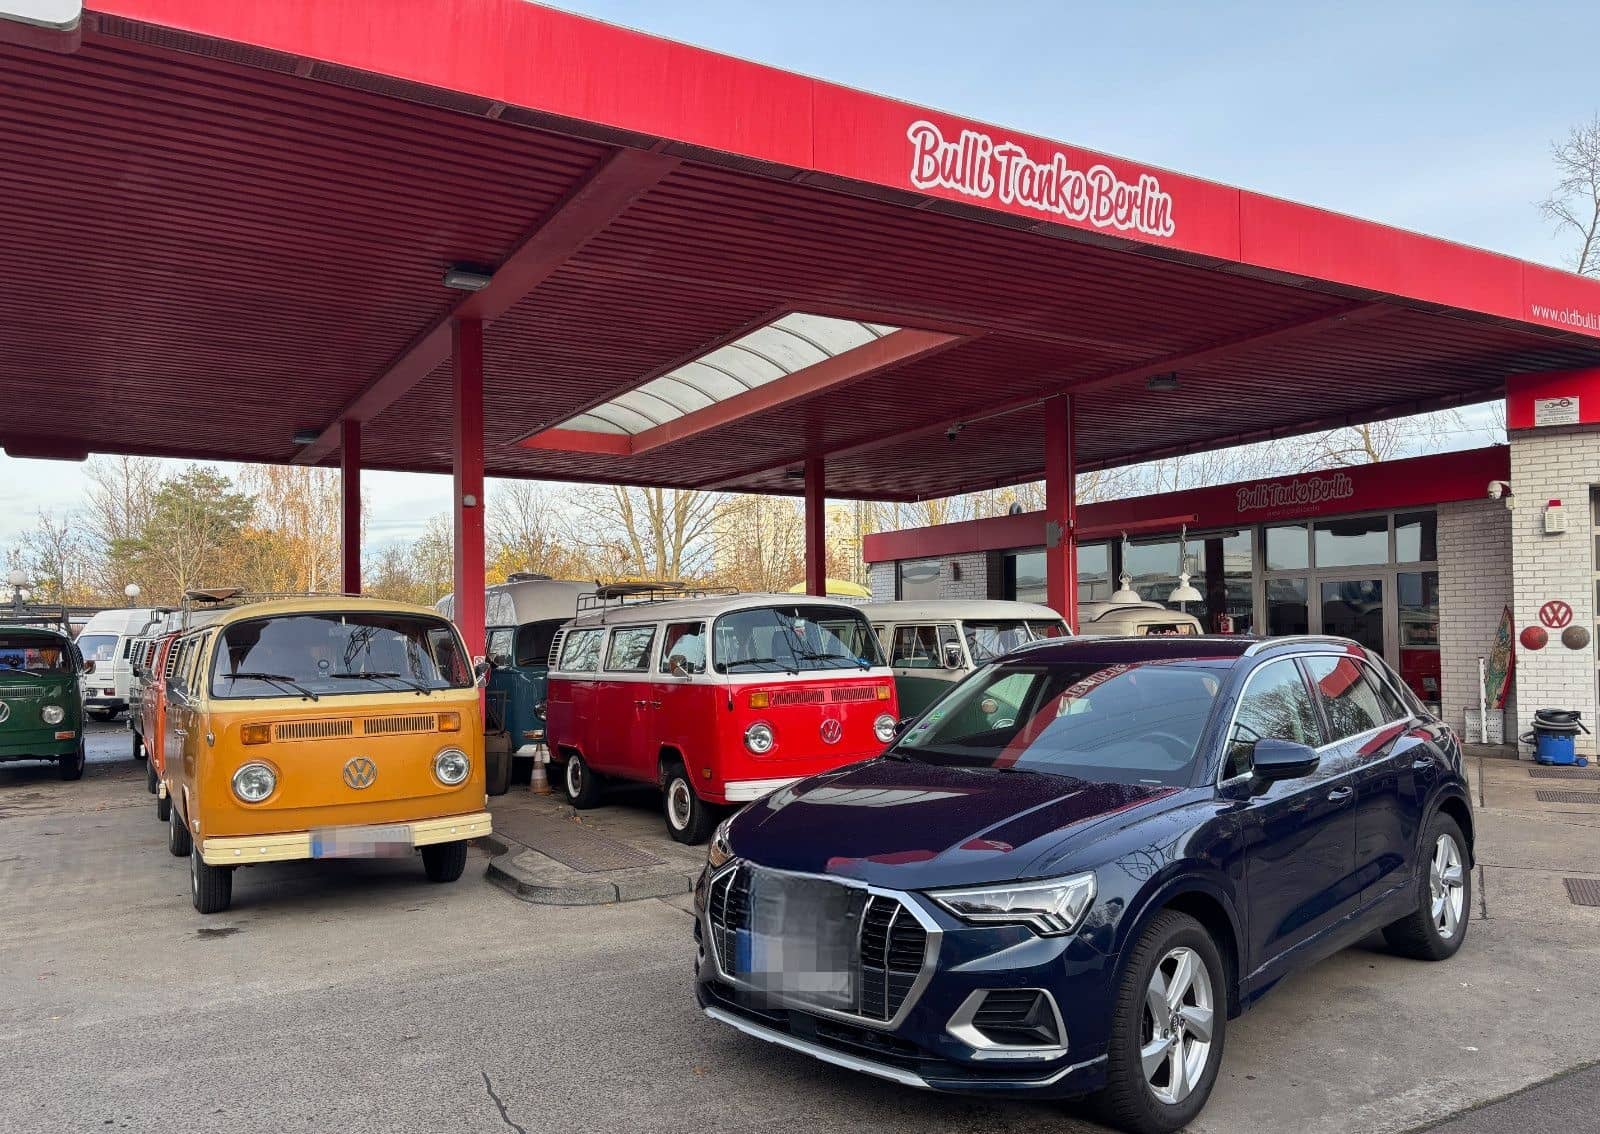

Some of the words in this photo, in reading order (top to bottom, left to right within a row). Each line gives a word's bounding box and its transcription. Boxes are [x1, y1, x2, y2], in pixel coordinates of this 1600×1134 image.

[907, 120, 994, 198] Bulli
[994, 142, 1087, 221] Tanke
[1087, 164, 1175, 237] Berlin
[1531, 303, 1600, 331] www.oldbulli.
[1236, 484, 1268, 512] Bulli
[1268, 479, 1308, 507] Tanke
[1308, 472, 1354, 503] Berlin
